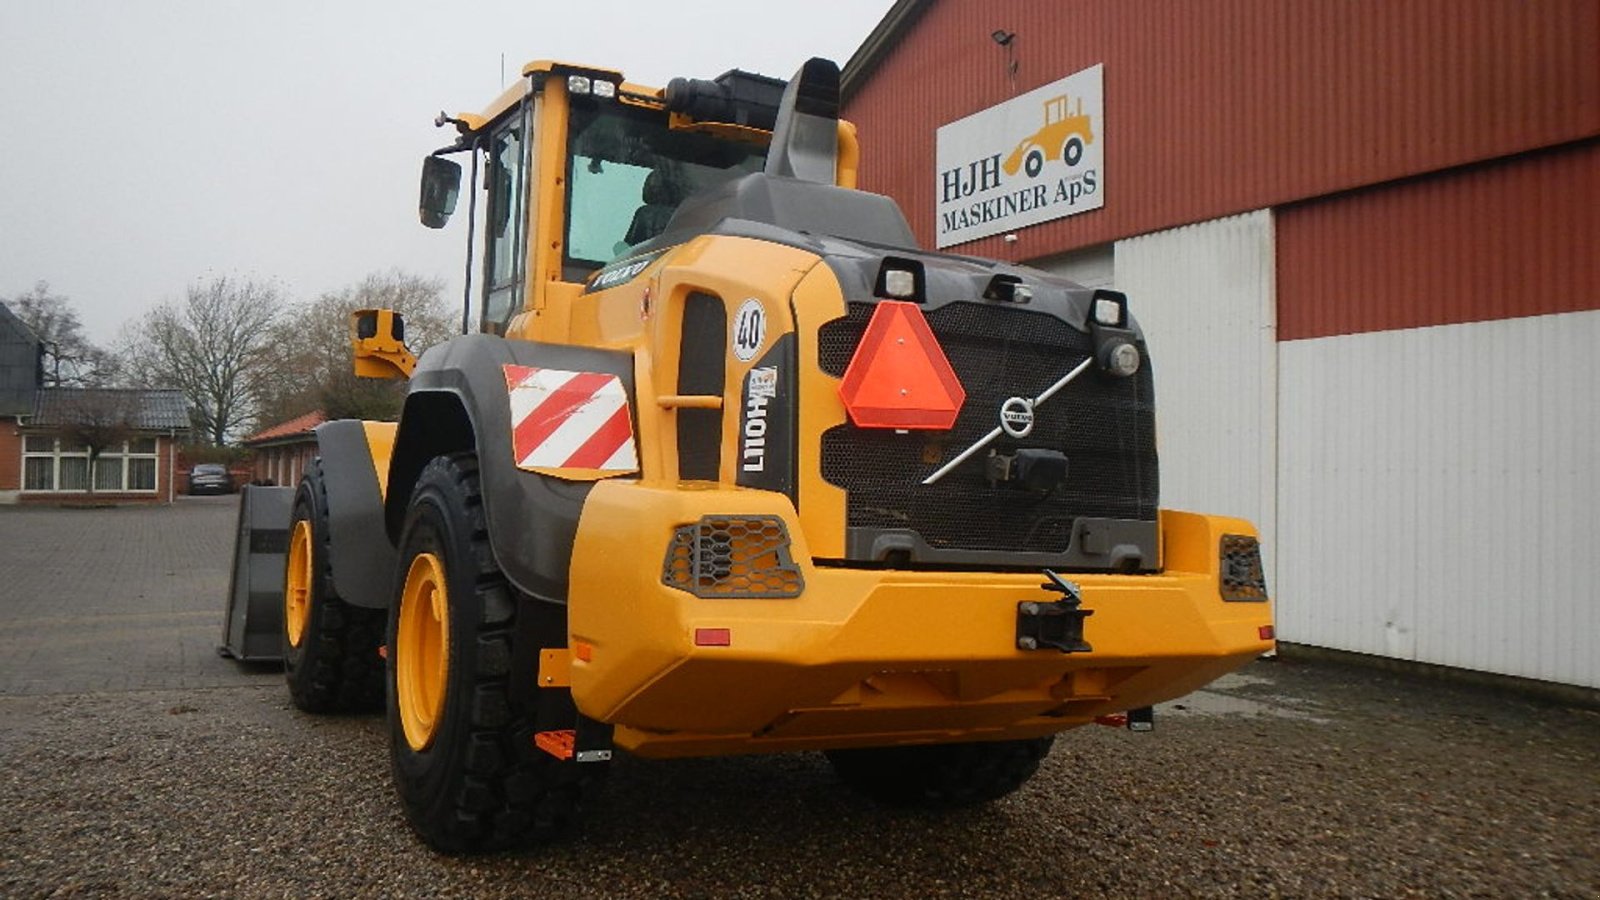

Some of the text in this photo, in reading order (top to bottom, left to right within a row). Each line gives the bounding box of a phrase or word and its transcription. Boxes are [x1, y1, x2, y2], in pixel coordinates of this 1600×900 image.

[941, 153, 1002, 204] HJH
[942, 169, 1096, 234] MASKINER ApS
[737, 309, 760, 349] 40
[743, 397, 769, 472] L110H
